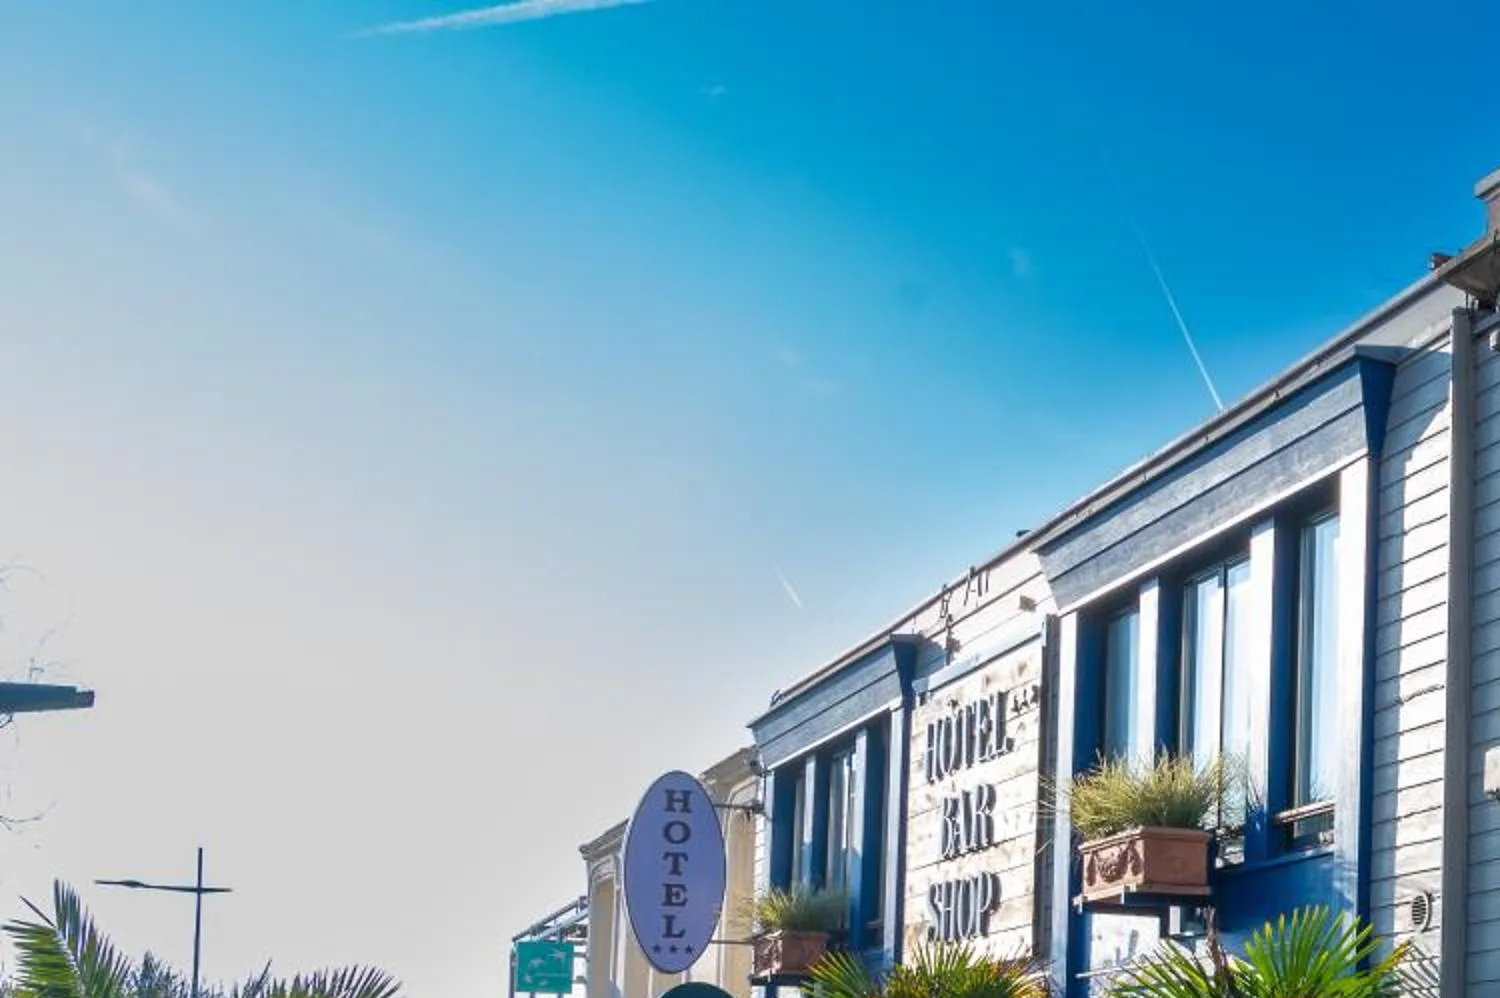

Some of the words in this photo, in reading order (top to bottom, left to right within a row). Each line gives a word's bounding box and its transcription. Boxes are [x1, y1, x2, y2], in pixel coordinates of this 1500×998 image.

[940, 783, 997, 860] BAR
[661, 789, 693, 939] HOTEL
[926, 872, 1002, 944] SHOP
